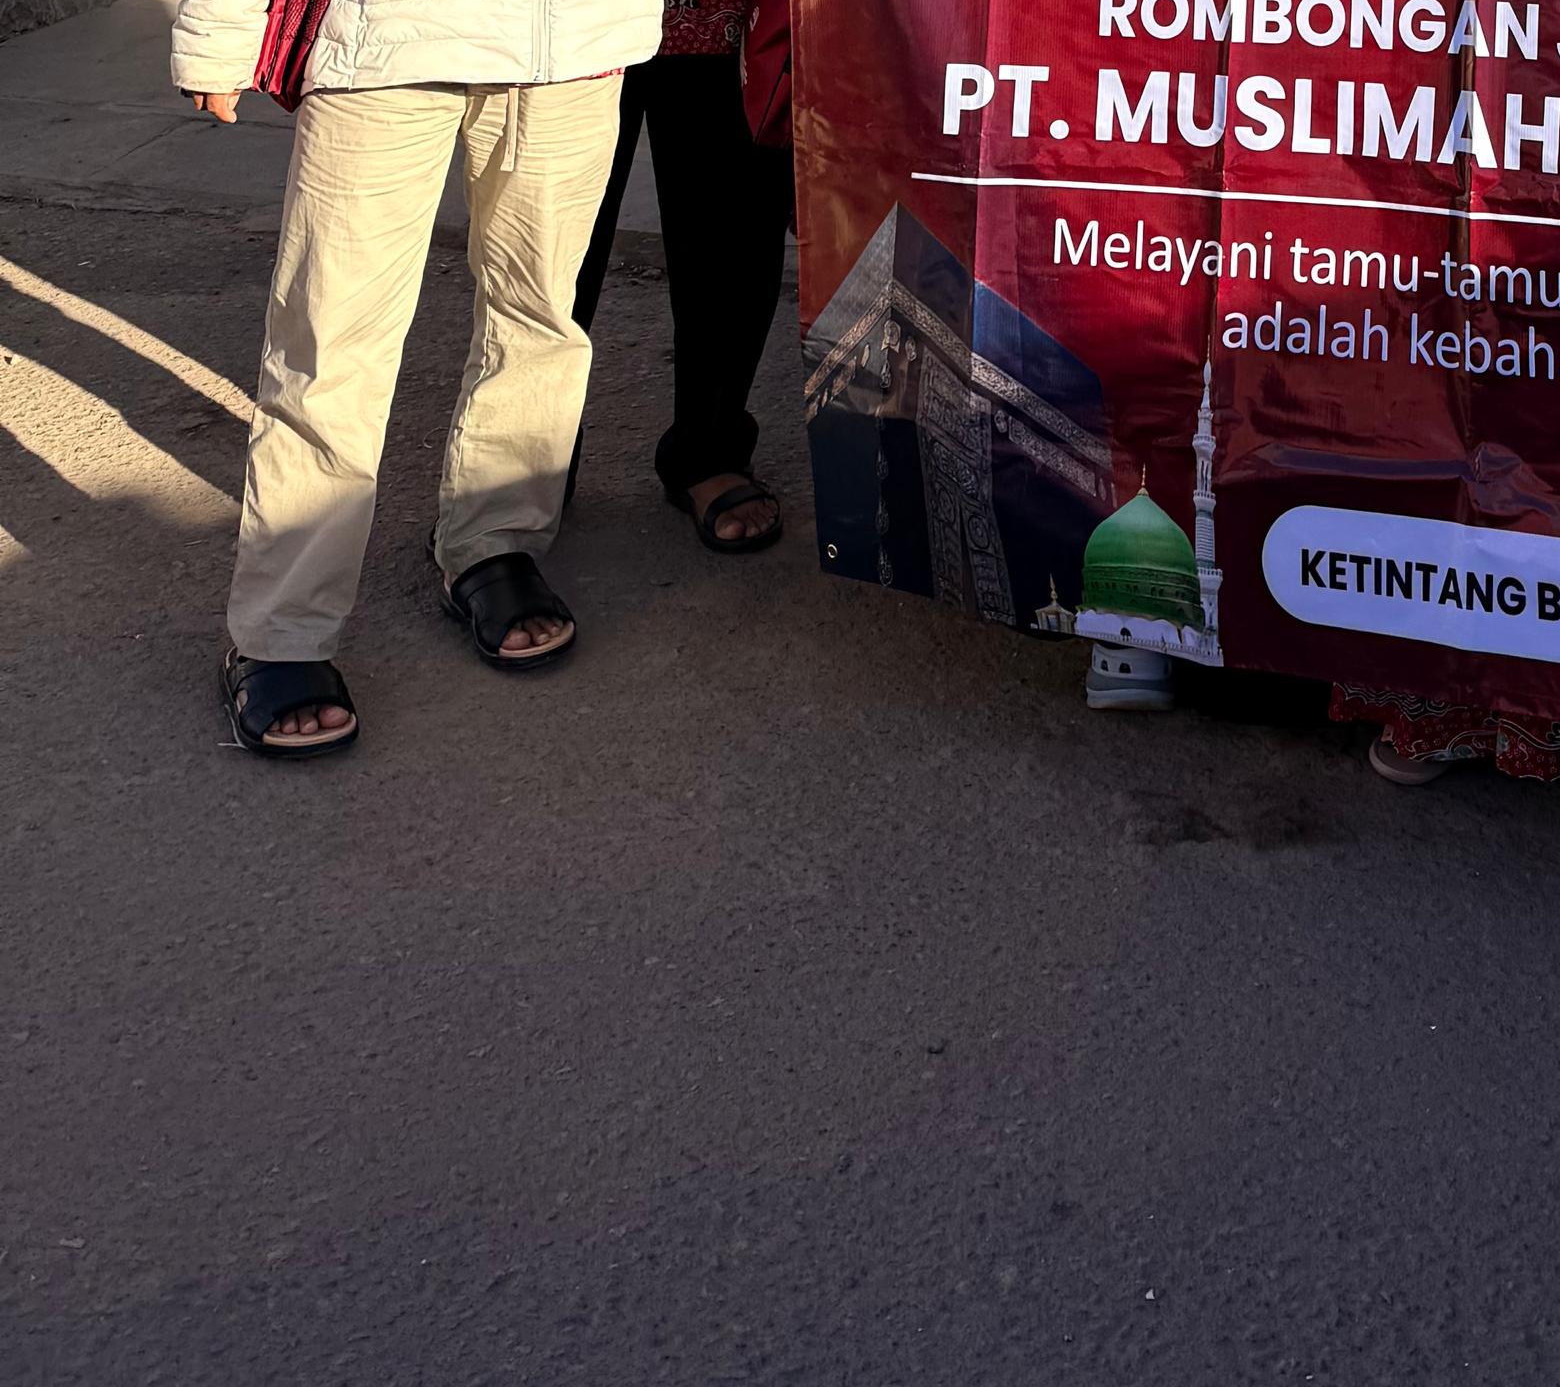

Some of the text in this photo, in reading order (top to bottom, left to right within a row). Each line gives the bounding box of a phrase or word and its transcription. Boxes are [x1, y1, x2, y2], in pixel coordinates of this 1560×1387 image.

[942, 63, 1070, 139] PT.
[1095, 69, 1560, 174] MUSLIMAH
[1054, 218, 1273, 287] Melayani
[1222, 304, 1389, 362] adalah
[1301, 548, 1527, 616] KETINTANG
